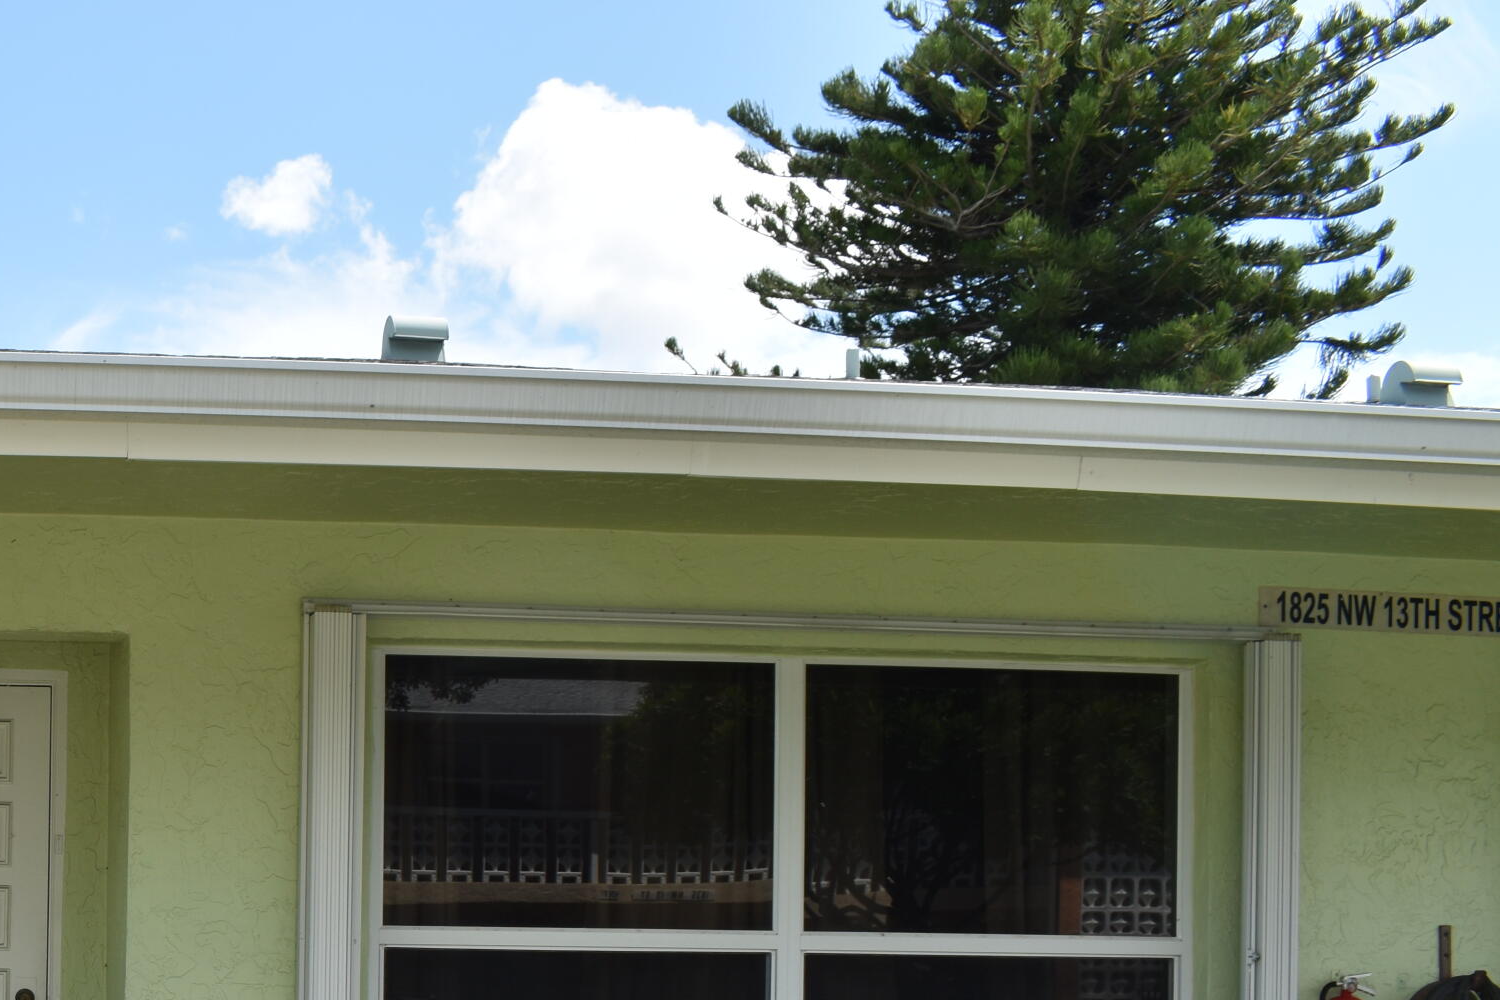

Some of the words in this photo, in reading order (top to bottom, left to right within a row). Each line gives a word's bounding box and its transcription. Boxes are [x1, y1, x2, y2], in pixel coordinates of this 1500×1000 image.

[1277, 591, 1330, 625] 1825
[1337, 594, 1377, 626] NW
[1384, 596, 1440, 630] 13TH
